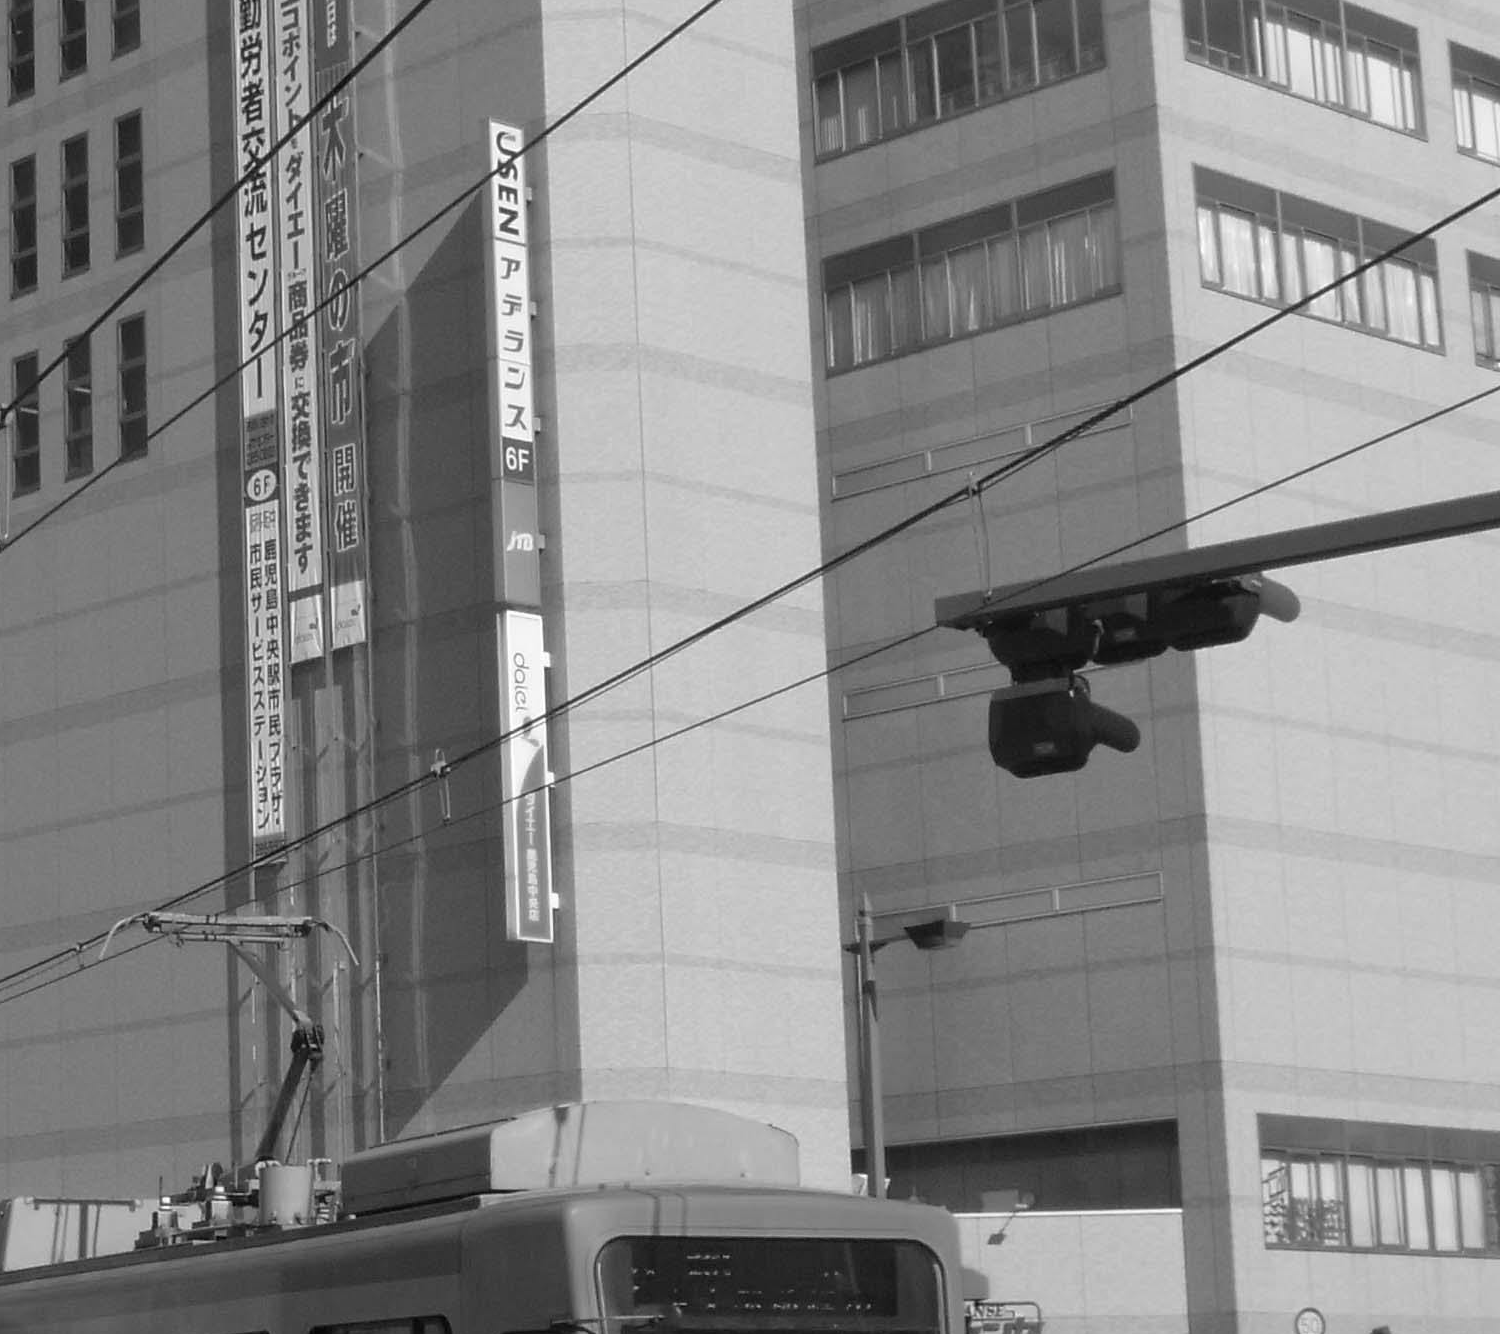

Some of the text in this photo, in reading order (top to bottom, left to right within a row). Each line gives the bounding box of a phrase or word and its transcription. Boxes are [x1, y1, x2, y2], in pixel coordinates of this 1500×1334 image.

[496, 131, 520, 236] USEN
[500, 256, 527, 431] アデランス
[253, 475, 271, 497] 6F
[505, 446, 530, 472] 6F
[250, 543, 270, 830] 市民サービスステーション
[513, 652, 530, 712] daiei
